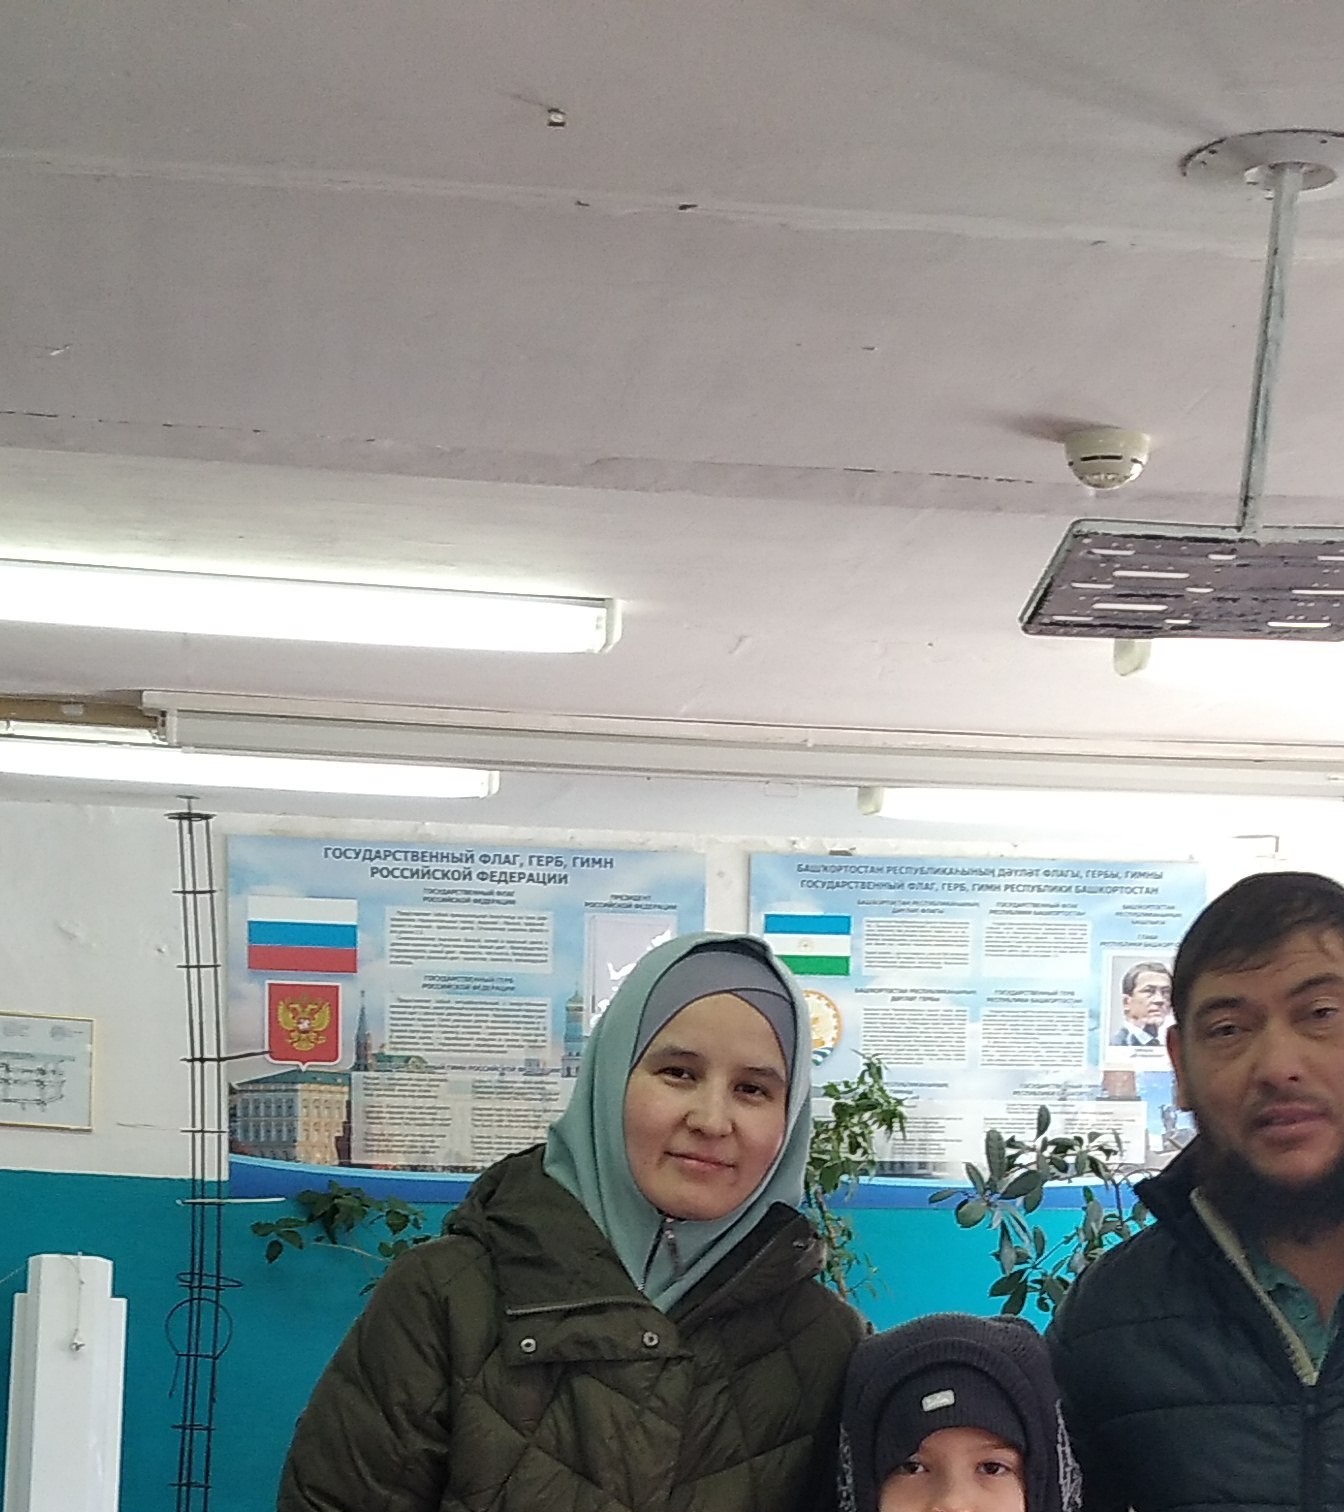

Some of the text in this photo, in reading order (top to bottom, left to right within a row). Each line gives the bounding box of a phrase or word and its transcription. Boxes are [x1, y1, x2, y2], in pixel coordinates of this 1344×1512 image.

[323, 846, 614, 869] ГОСУДАРСТВЕННЫЙ ФЛАГ, ГЕРБ, ГИМН
[370, 865, 569, 886] РОССИЙСКОЙ ФЕДЕРАЦИИ
[800, 879, 905, 891] ГОСУДАРСТВЕННЫЙ
[971, 883, 1001, 893] ГИМН
[1004, 884, 1073, 894] РЕСПУБЛИКИ
[1074, 885, 1159, 895] БАШКОРТОСТАН
